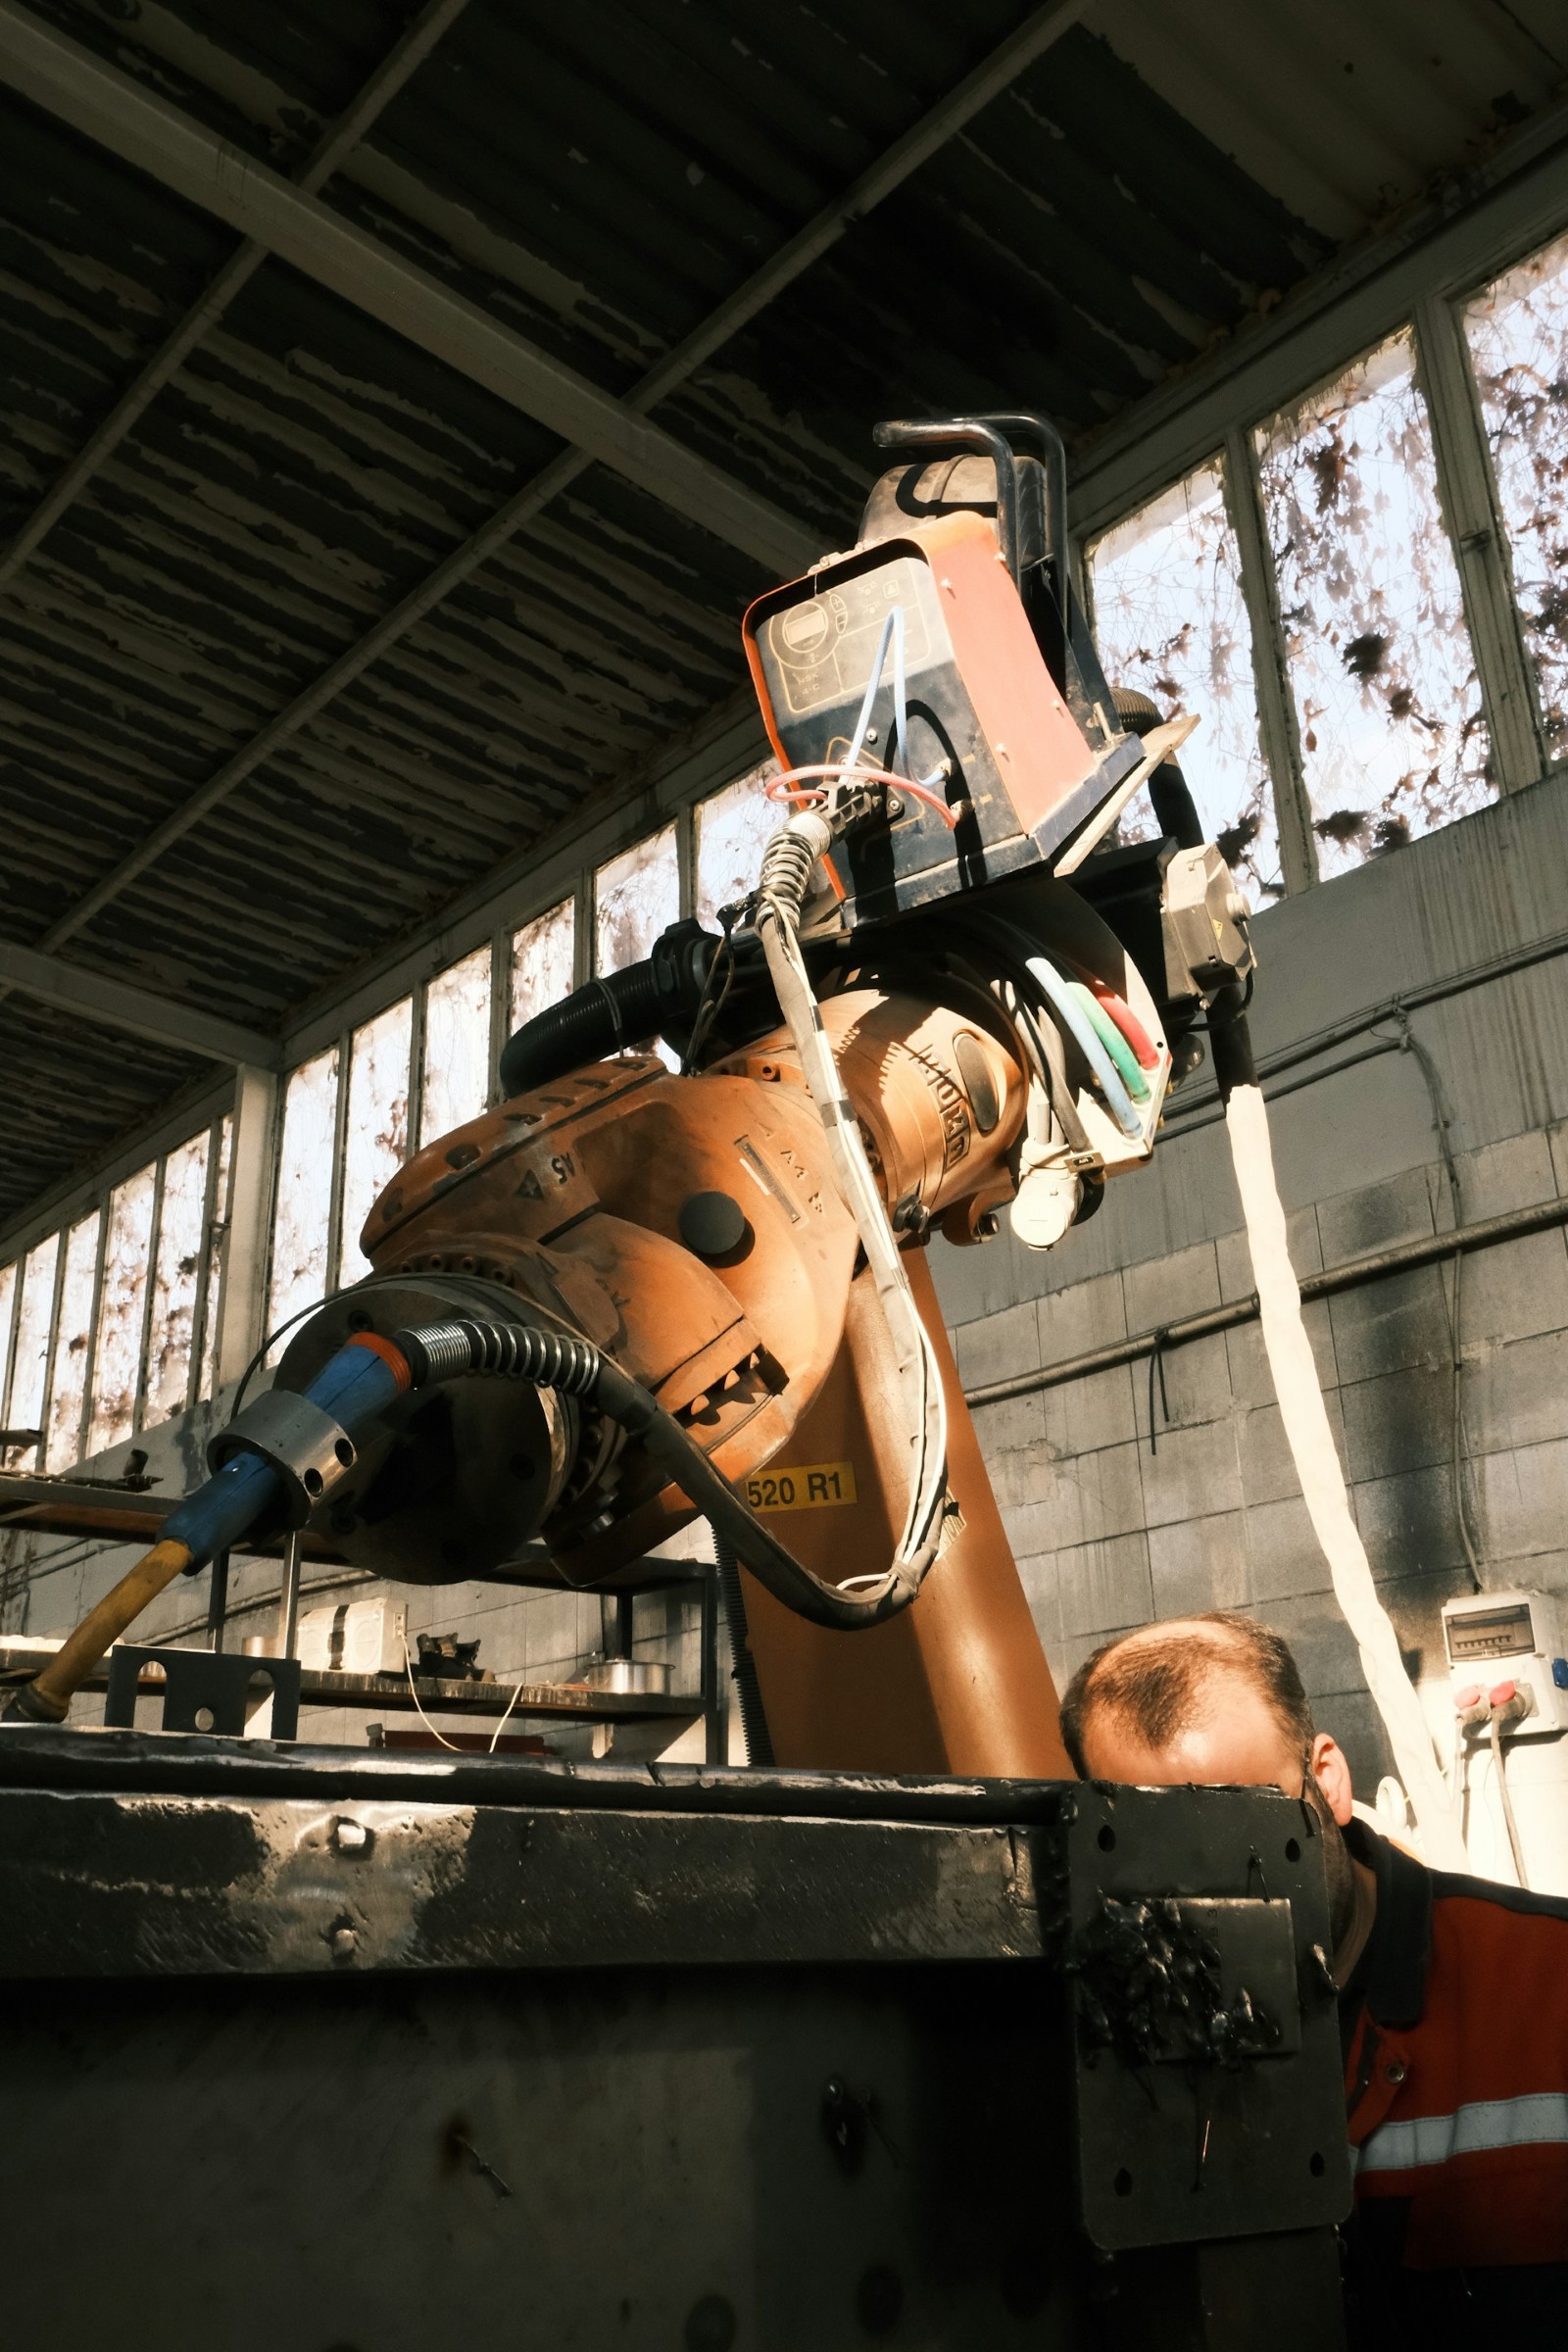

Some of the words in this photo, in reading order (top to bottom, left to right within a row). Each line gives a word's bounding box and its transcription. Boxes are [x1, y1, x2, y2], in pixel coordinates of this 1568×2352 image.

[780, 1150, 807, 1180] A4
[748, 1476, 795, 1507] 520
[808, 1472, 842, 1501] R1
